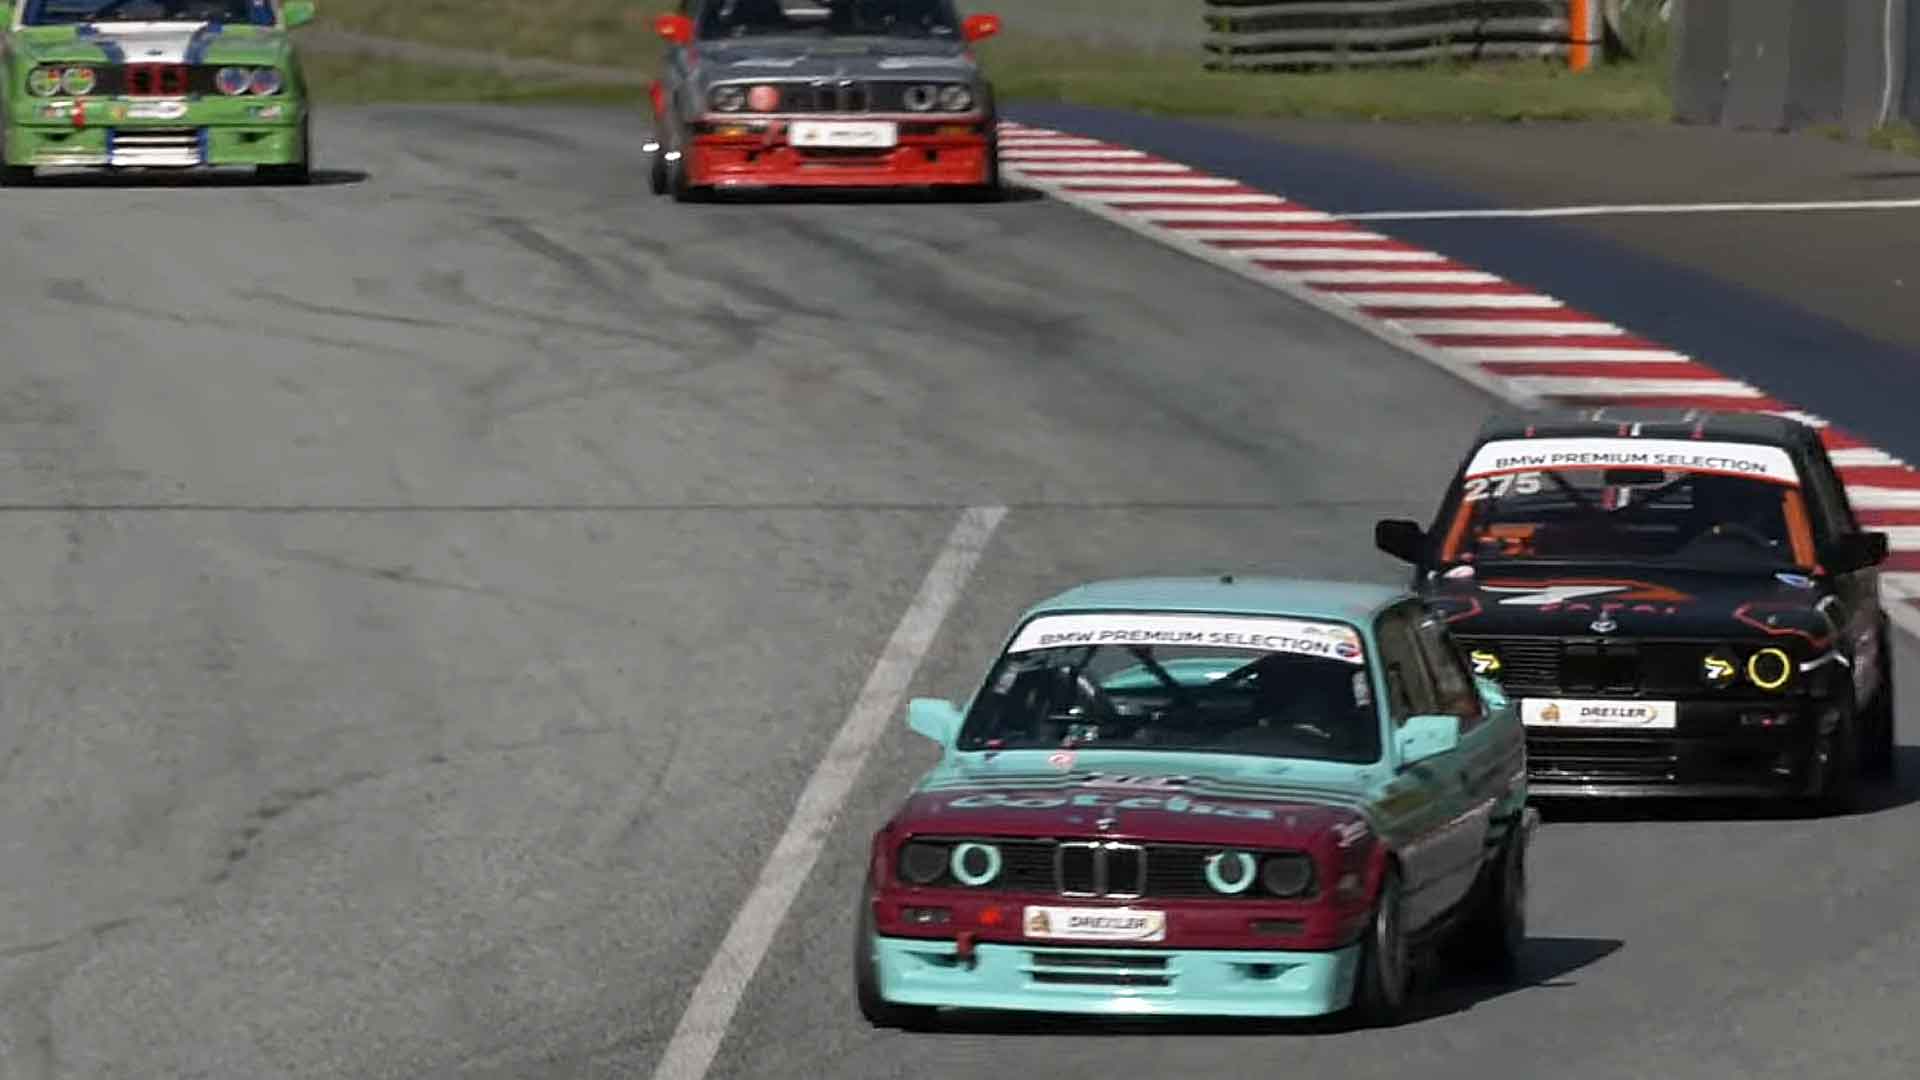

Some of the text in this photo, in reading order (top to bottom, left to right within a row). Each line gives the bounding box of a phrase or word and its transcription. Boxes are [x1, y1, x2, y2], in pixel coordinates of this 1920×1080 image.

[1495, 452, 1768, 473] BMW PREMIUM SELECTION
[1463, 472, 1542, 501] 275
[1039, 630, 1096, 645] BMW
[1098, 629, 1204, 642] PREMIUM
[1208, 632, 1330, 653] SELECTION
[1579, 706, 1647, 718] DREXLER
